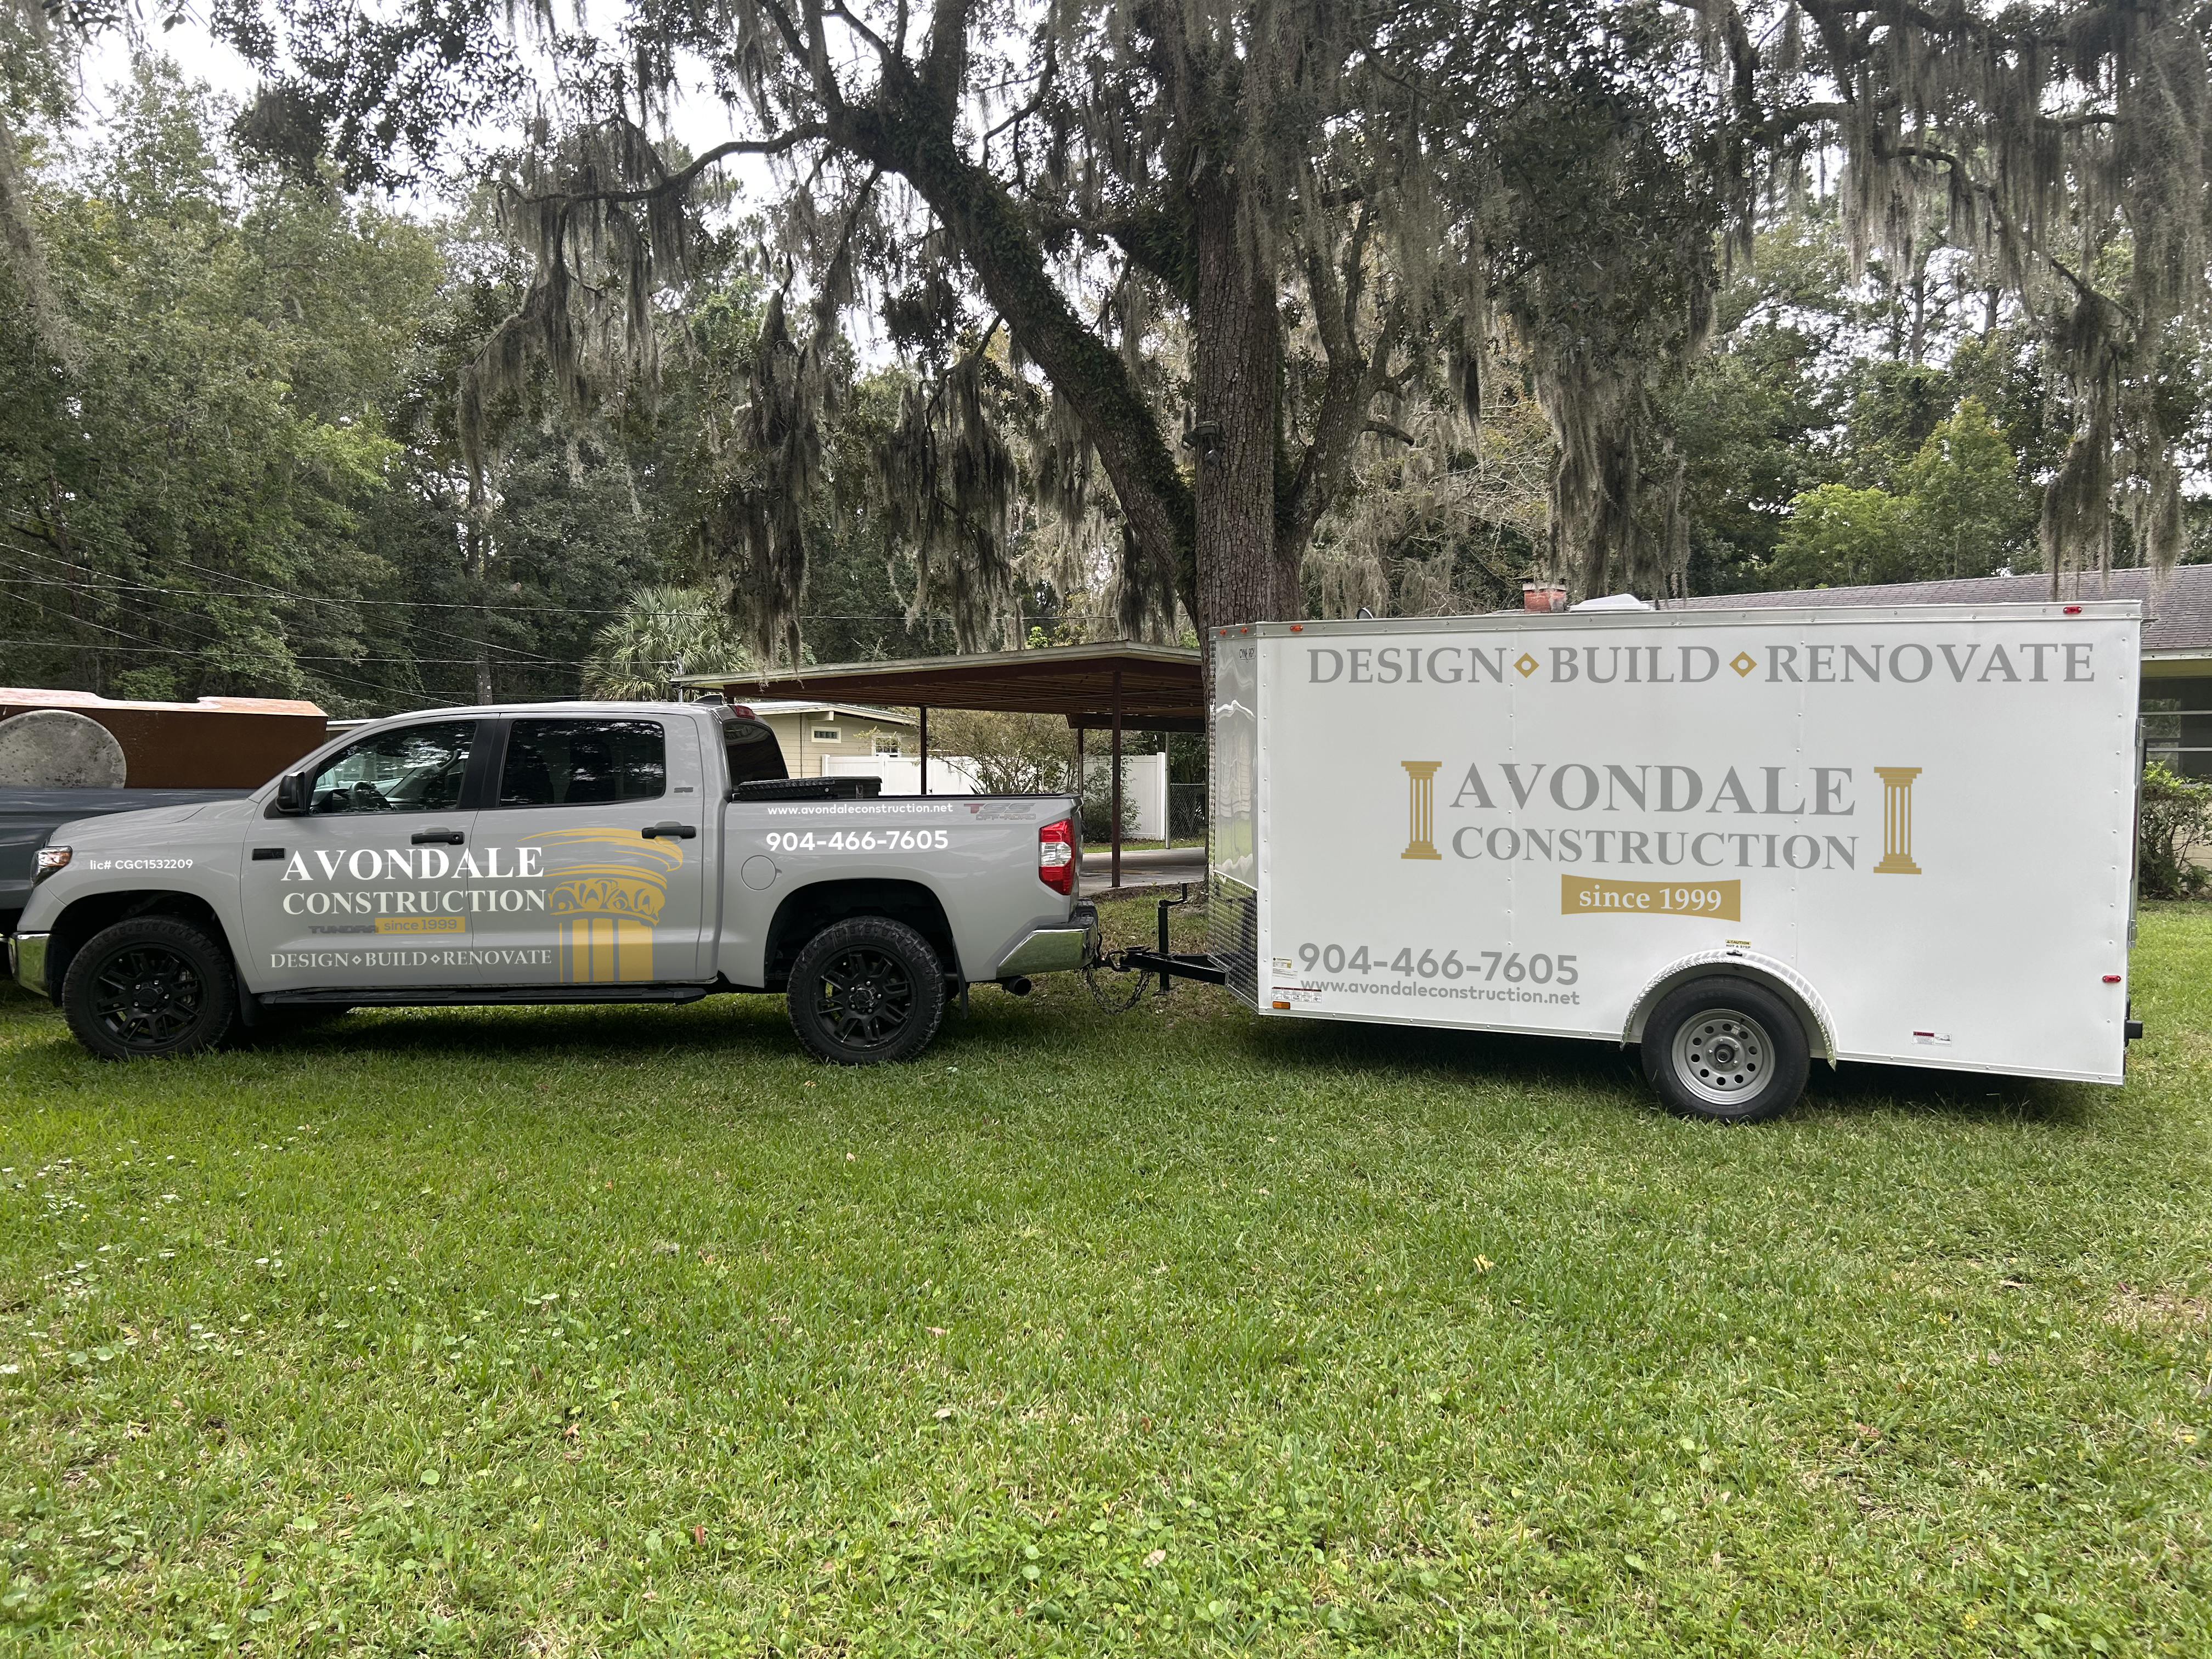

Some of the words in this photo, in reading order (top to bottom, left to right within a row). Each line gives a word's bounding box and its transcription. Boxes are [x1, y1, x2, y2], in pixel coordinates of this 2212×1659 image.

[1307, 646, 1506, 684] DESIGN
[1550, 646, 1719, 684] BUILD
[1765, 643, 2096, 683] RENOVATE
[1449, 762, 1855, 816] AVONDALE
[768, 803, 953, 815] www.avondaleconstruction.net
[766, 830, 949, 851] 904-466-7605
[1452, 826, 1859, 871] CONSTRUCTION
[90, 860, 111, 870] lic#
[115, 859, 193, 869] CGC1532209
[280, 847, 544, 881] AVONDALE
[283, 889, 546, 915] CONSTRUCTION
[1579, 884, 1650, 909] since
[1659, 888, 1722, 911] 1999
[308, 925, 379, 934] TUNDRA
[384, 920, 419, 930] since
[421, 919, 457, 930] 1999
[270, 953, 349, 968] DESIGN
[365, 951, 427, 967] BUILD
[442, 950, 552, 966] RENOVATE
[1299, 943, 1578, 985] 904-466-7605
[1300, 980, 1580, 1005] www.avondaleconstruction.net
